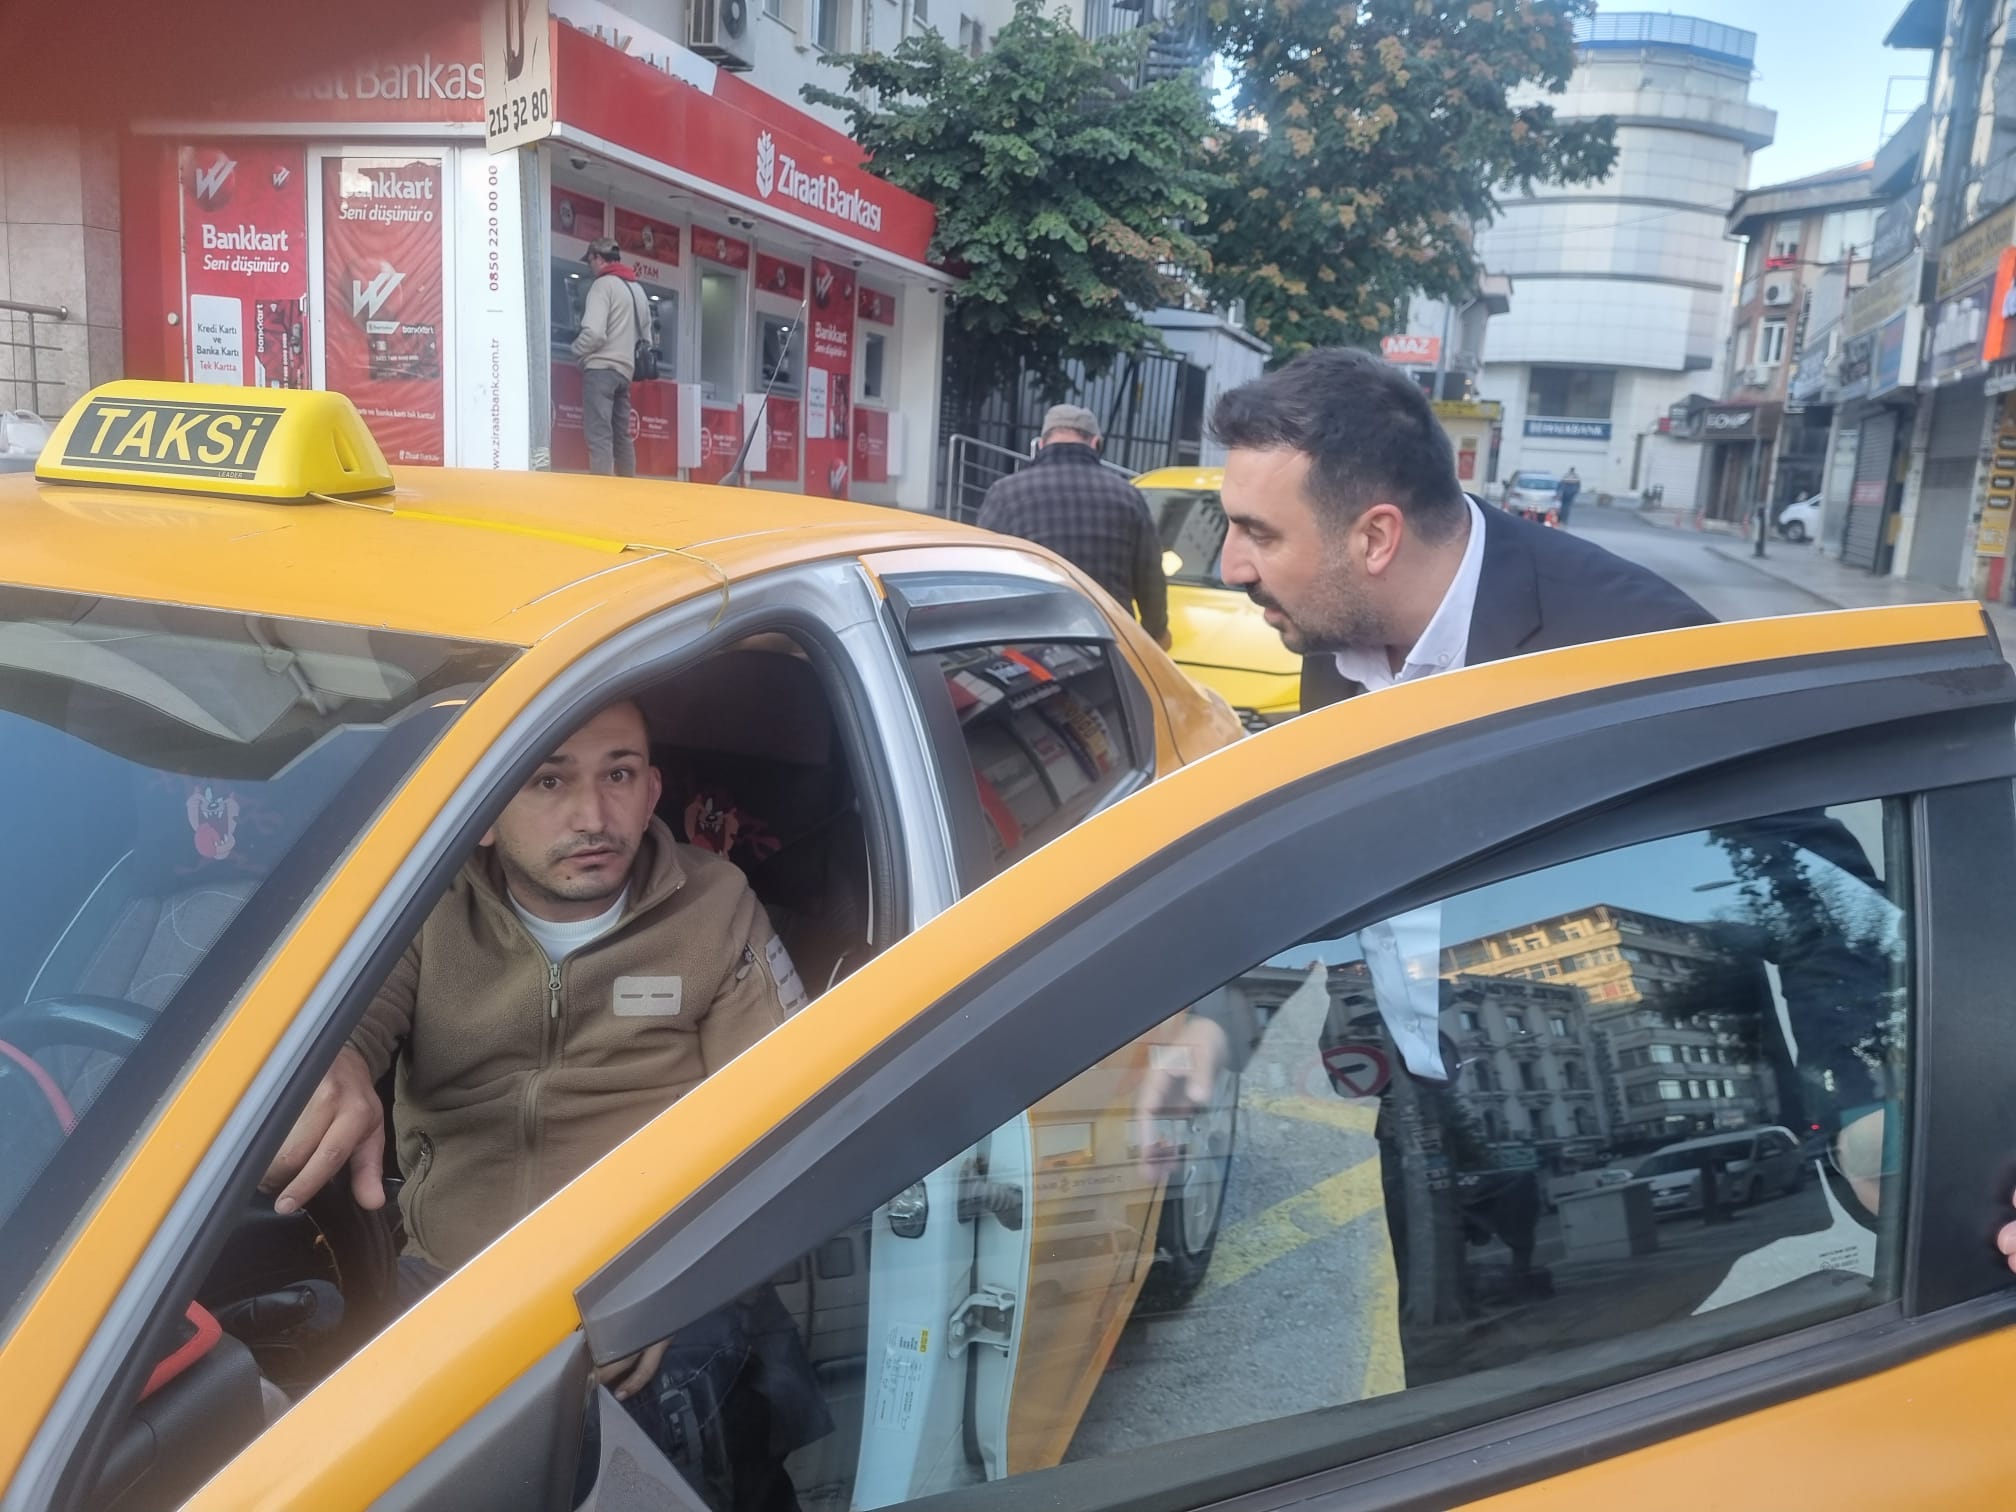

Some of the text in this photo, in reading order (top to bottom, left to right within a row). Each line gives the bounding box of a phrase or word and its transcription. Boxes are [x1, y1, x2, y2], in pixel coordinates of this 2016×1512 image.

[356, 52, 485, 100] Bankas
[489, 87, 549, 138] 215 32 80
[777, 154, 882, 232] Ziraat Bankası
[339, 201, 366, 220] Seni
[202, 224, 289, 251] Bankkart
[488, 165, 499, 291] 0850 220 00 00
[203, 254, 229, 271] Seni
[197, 323, 237, 335] Kredi Kartı
[196, 345, 220, 356] Banka
[200, 360, 214, 370] Tek
[490, 338, 500, 470] ww.ziraatbank.com.tr
[218, 471, 244, 479] LEADER
